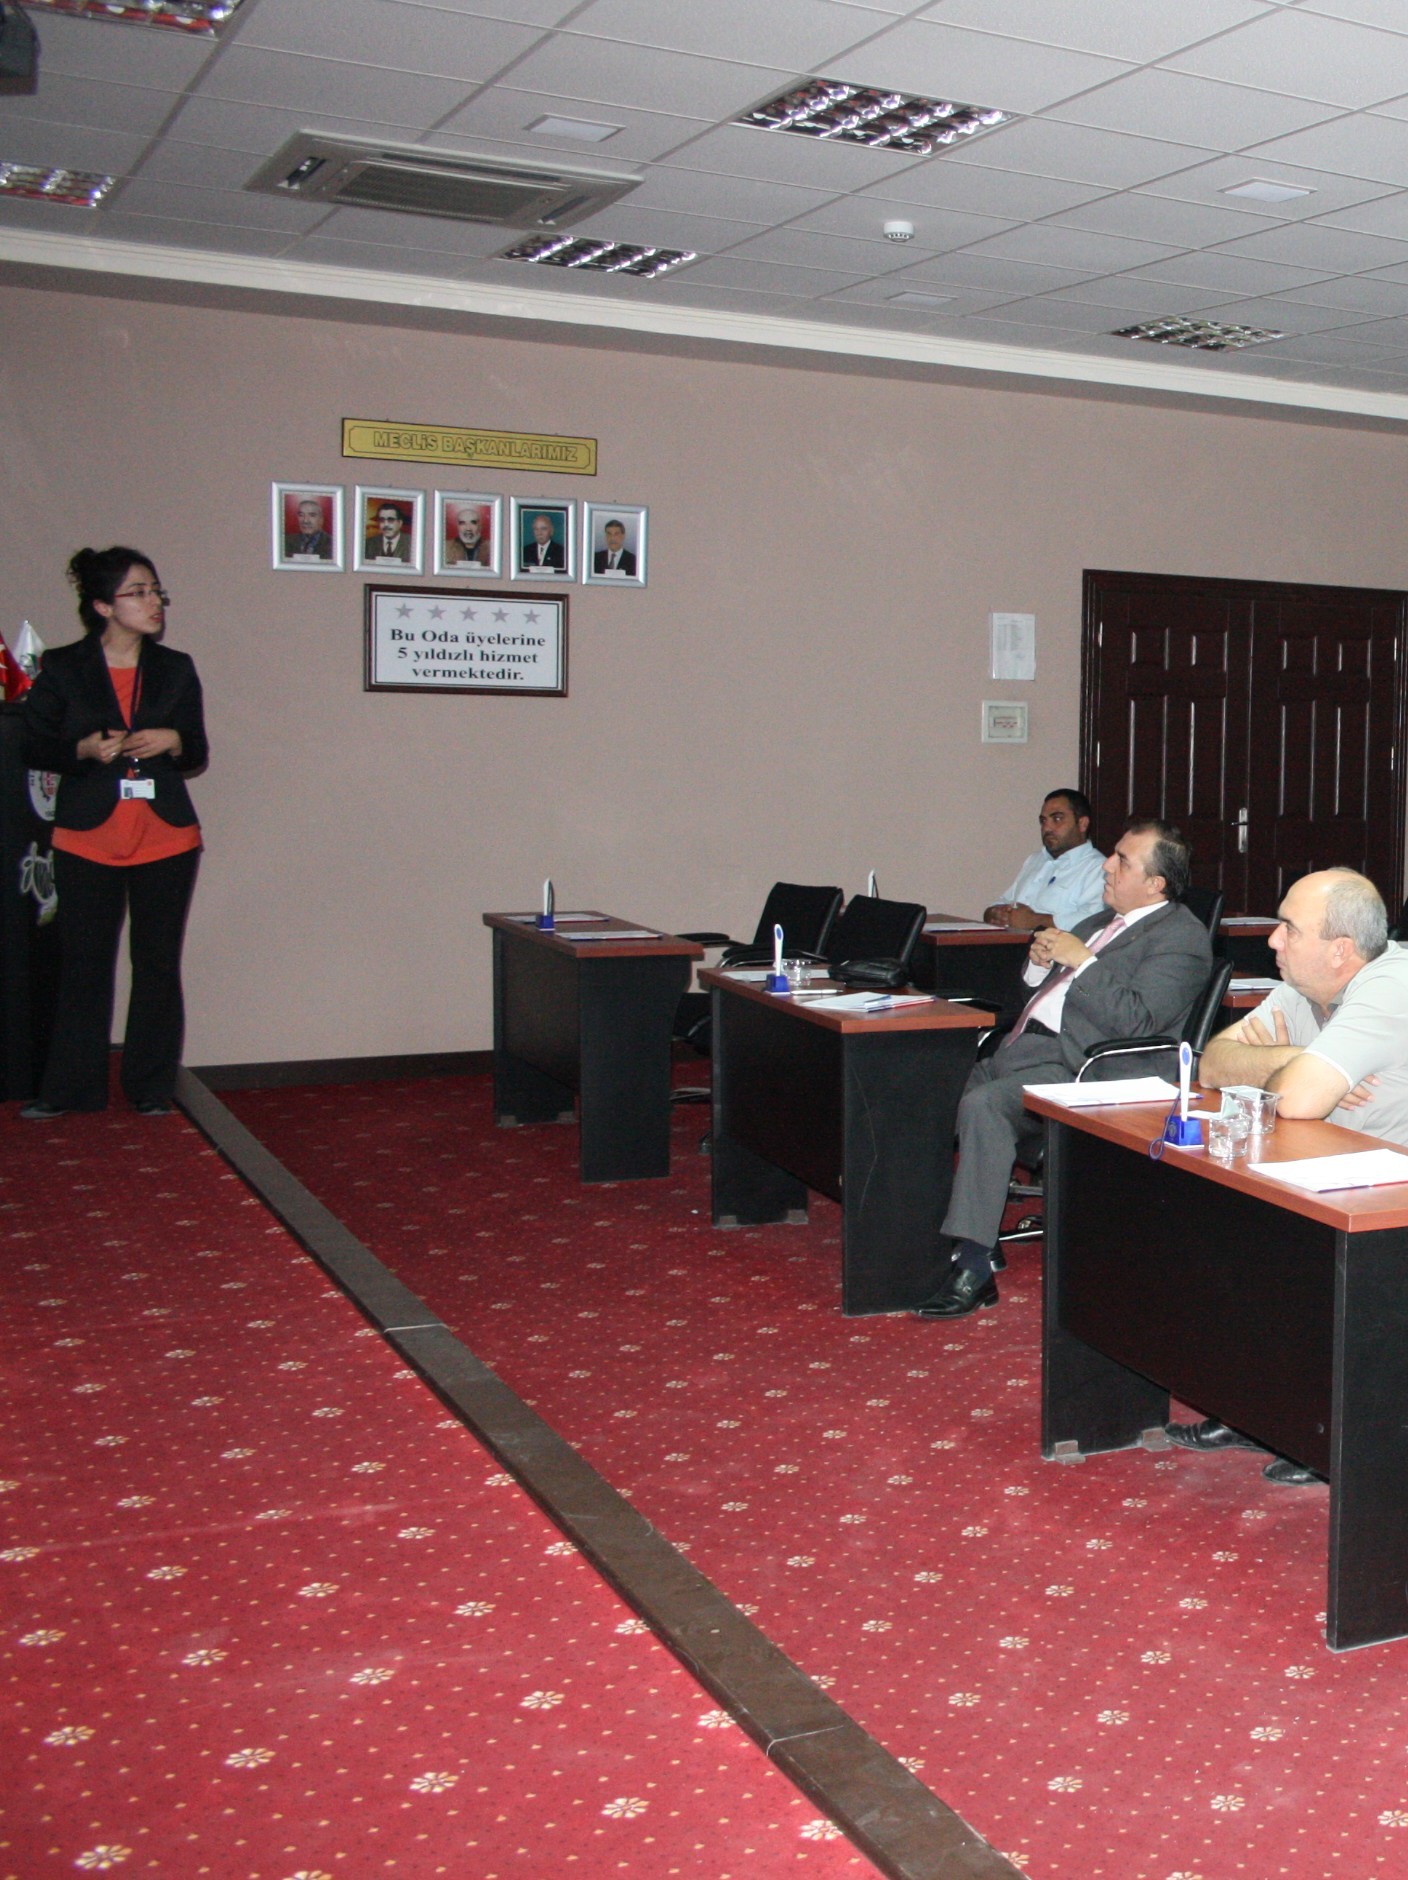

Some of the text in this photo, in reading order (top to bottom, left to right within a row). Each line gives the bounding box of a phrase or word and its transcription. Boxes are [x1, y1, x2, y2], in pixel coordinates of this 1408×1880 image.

[442, 435, 578, 462] BAŞKANLARIMIZ
[390, 628, 546, 647] Bu Oda üyelerine
[398, 647, 538, 663] 5 yıldızlı hizmet
[412, 667, 524, 680] vermektedir.
